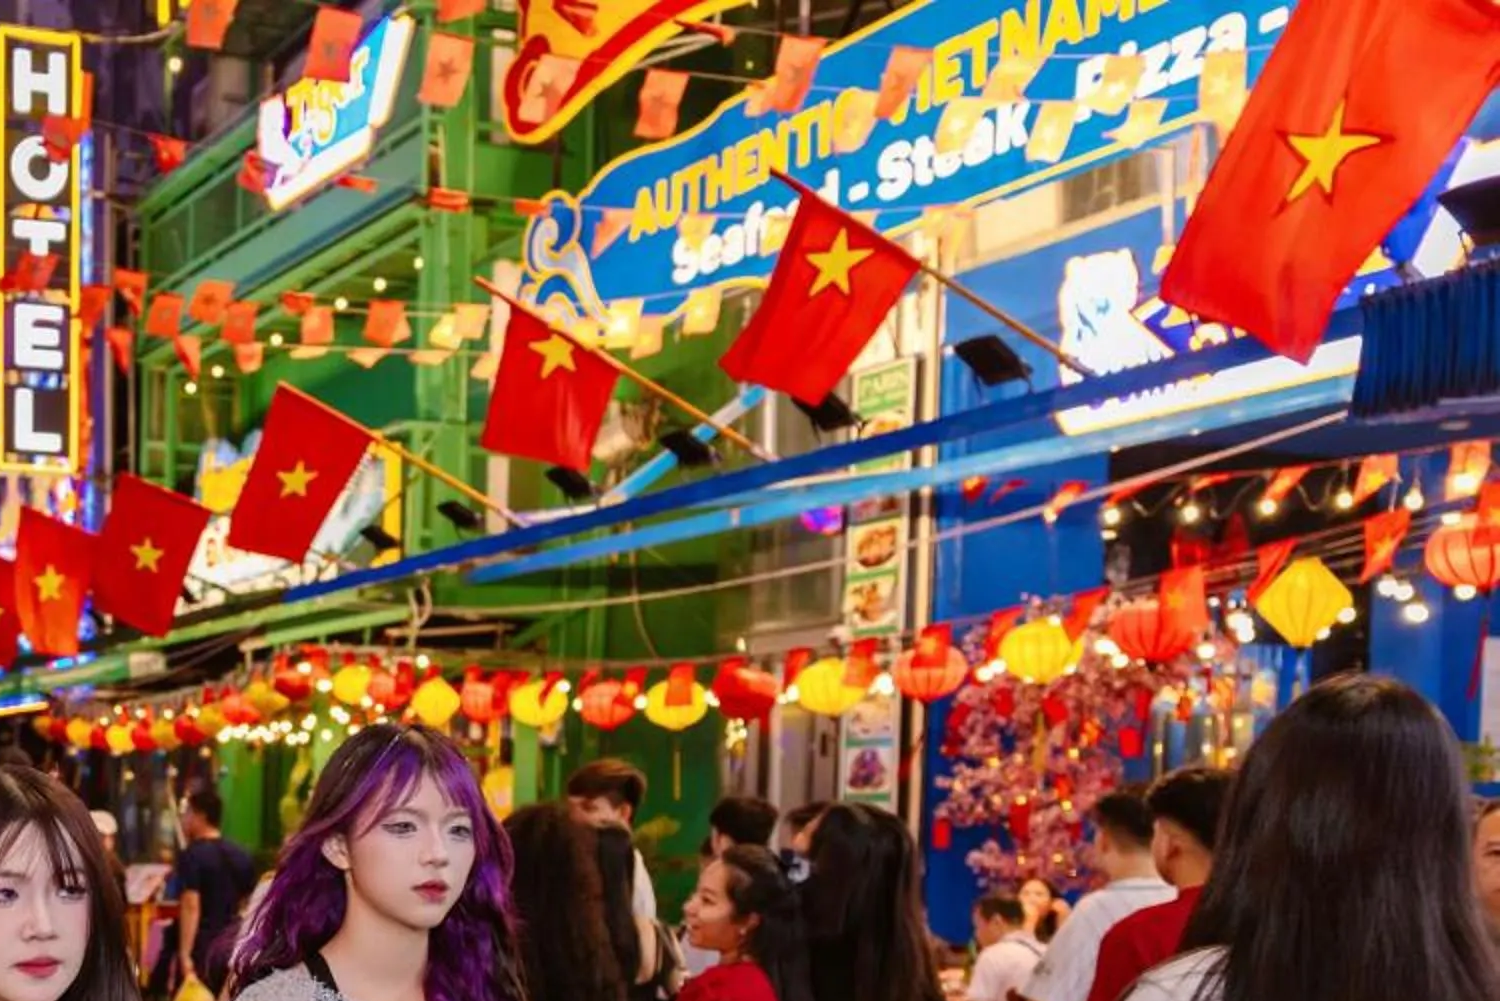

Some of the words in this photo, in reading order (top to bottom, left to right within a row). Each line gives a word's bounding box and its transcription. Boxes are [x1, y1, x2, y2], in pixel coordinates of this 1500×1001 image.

[11, 46, 67, 454] HOTEL
[672, 169, 840, 284] Seafd
[1074, 12, 1247, 123] Pzza
